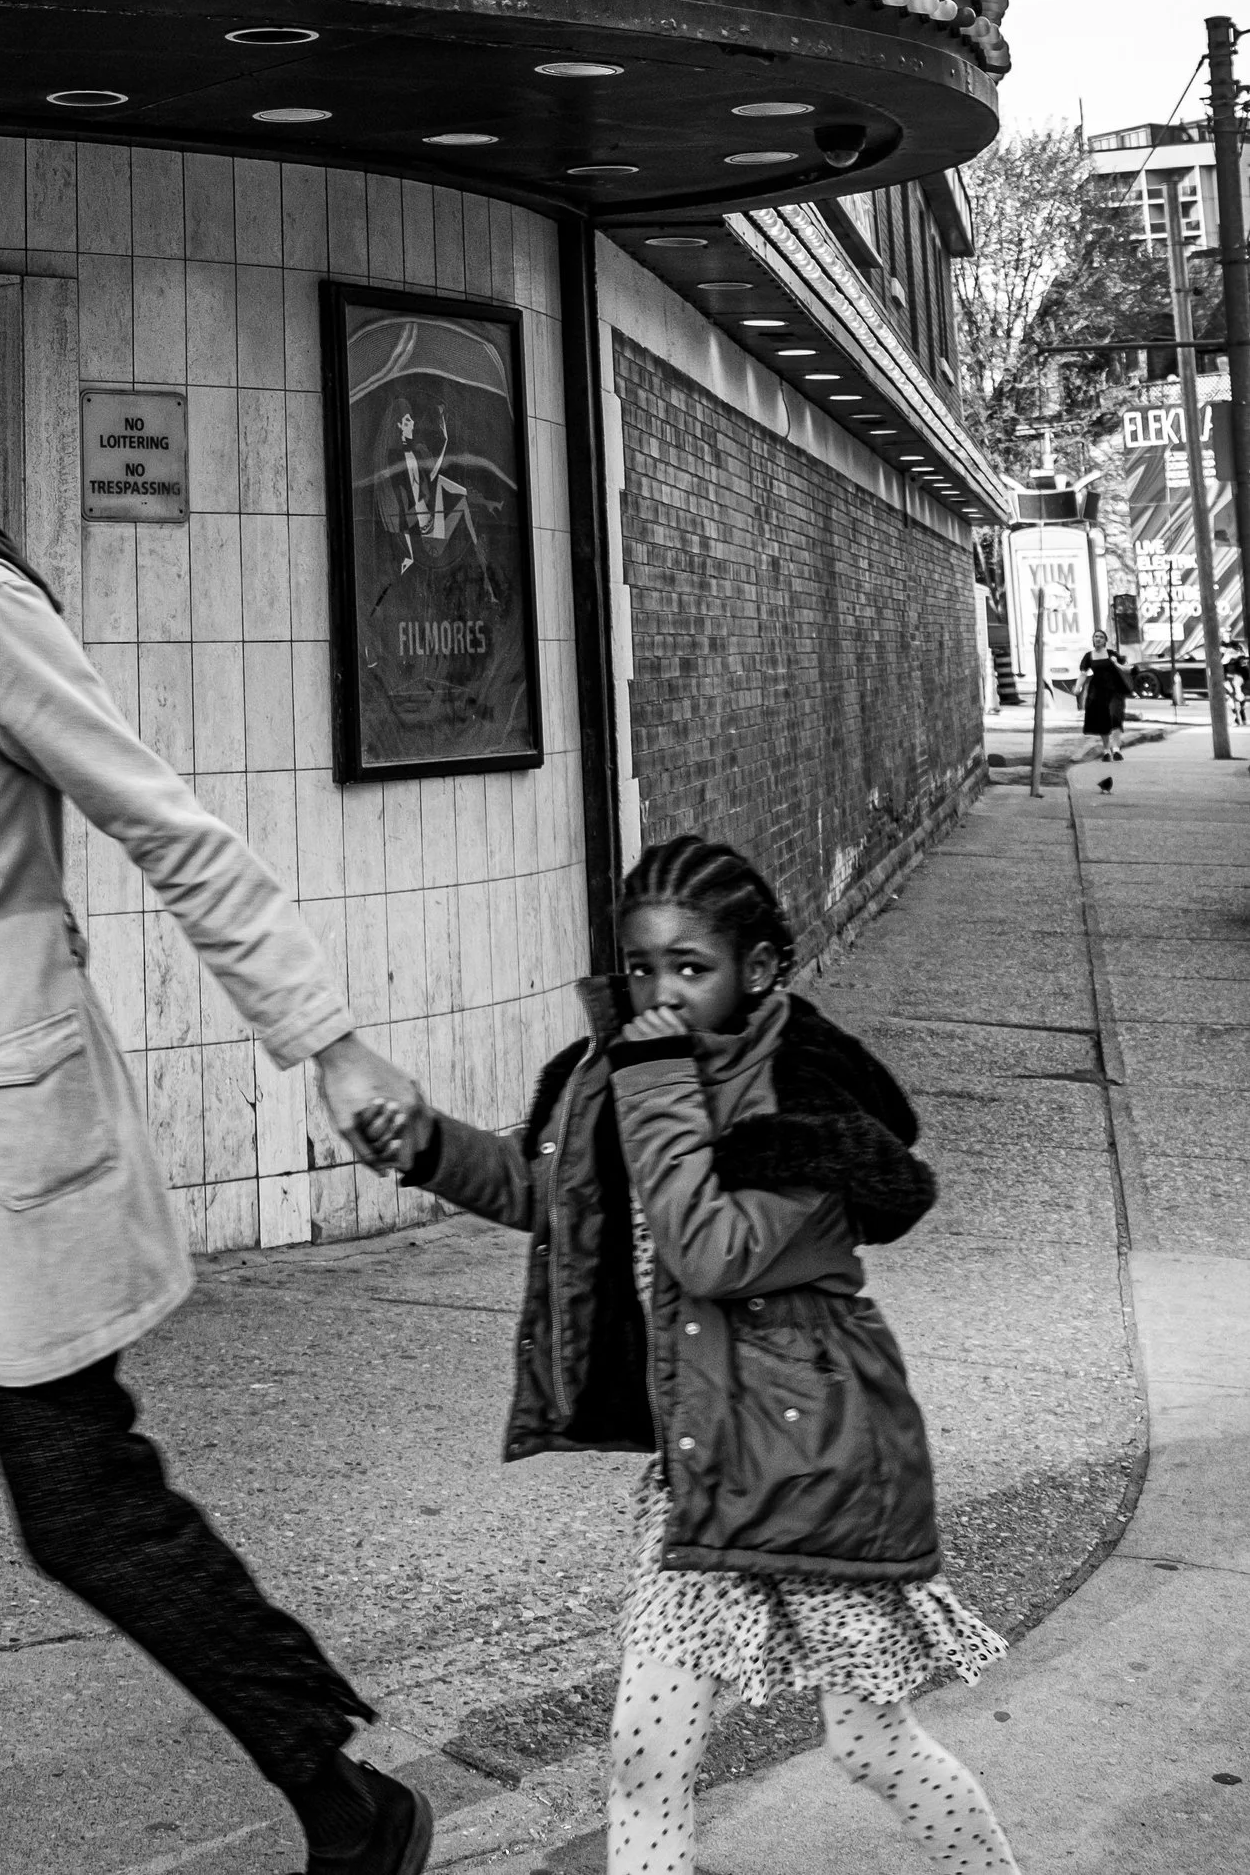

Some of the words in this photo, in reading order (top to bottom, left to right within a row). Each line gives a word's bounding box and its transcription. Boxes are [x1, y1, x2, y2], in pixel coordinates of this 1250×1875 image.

[124, 417, 145, 432] NO
[99, 434, 170, 450] LOITERING
[125, 463, 146, 477] NO
[89, 480, 181, 496] TRESPASSING
[1029, 563, 1076, 585] YUM
[1033, 611, 1080, 634] UM
[398, 620, 486, 656] FILMORES
